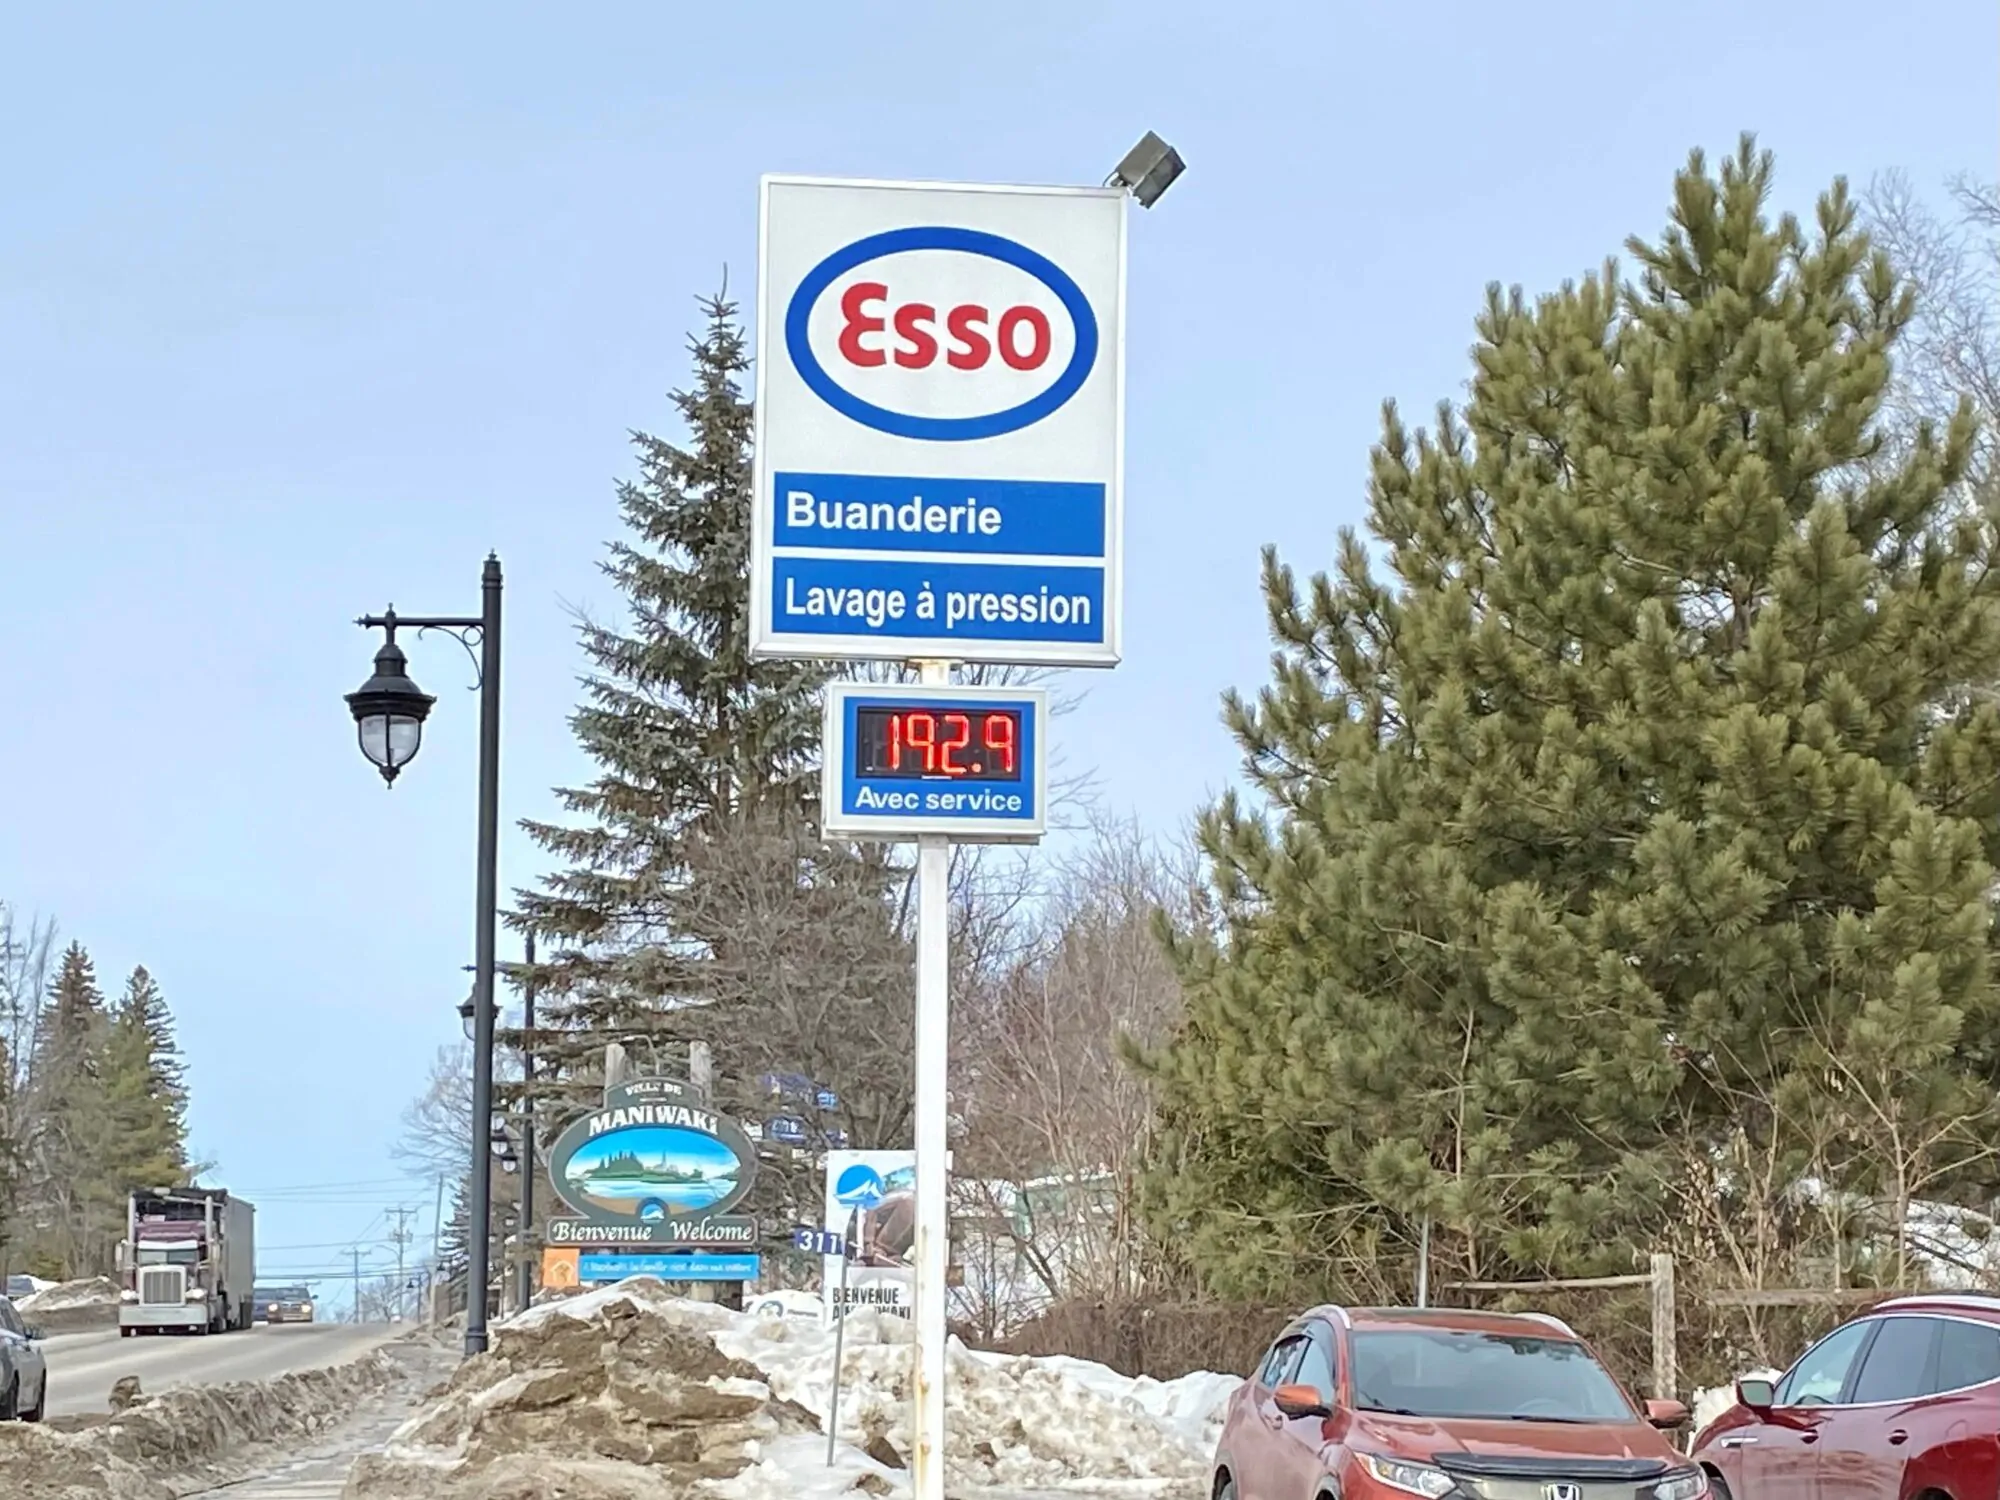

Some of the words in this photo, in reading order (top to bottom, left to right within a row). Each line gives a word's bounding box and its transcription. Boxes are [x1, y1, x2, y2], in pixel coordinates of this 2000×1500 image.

[837, 282, 1052, 372] Esso
[786, 490, 1002, 535] Buanderie
[785, 578, 907, 628] Lavage
[915, 582, 936, 620] à
[946, 586, 1091, 629] pression
[888, 713, 1015, 775] 192.9
[855, 786, 920, 810] Avec
[925, 788, 1022, 812] service
[663, 1082, 683, 1096] DE
[588, 1105, 719, 1137] MANIWAKI
[552, 1221, 653, 1242] Bienvenue
[669, 1217, 753, 1241] Welcome
[799, 1230, 838, 1254] 311
[832, 1287, 900, 1304] BENVENUE
